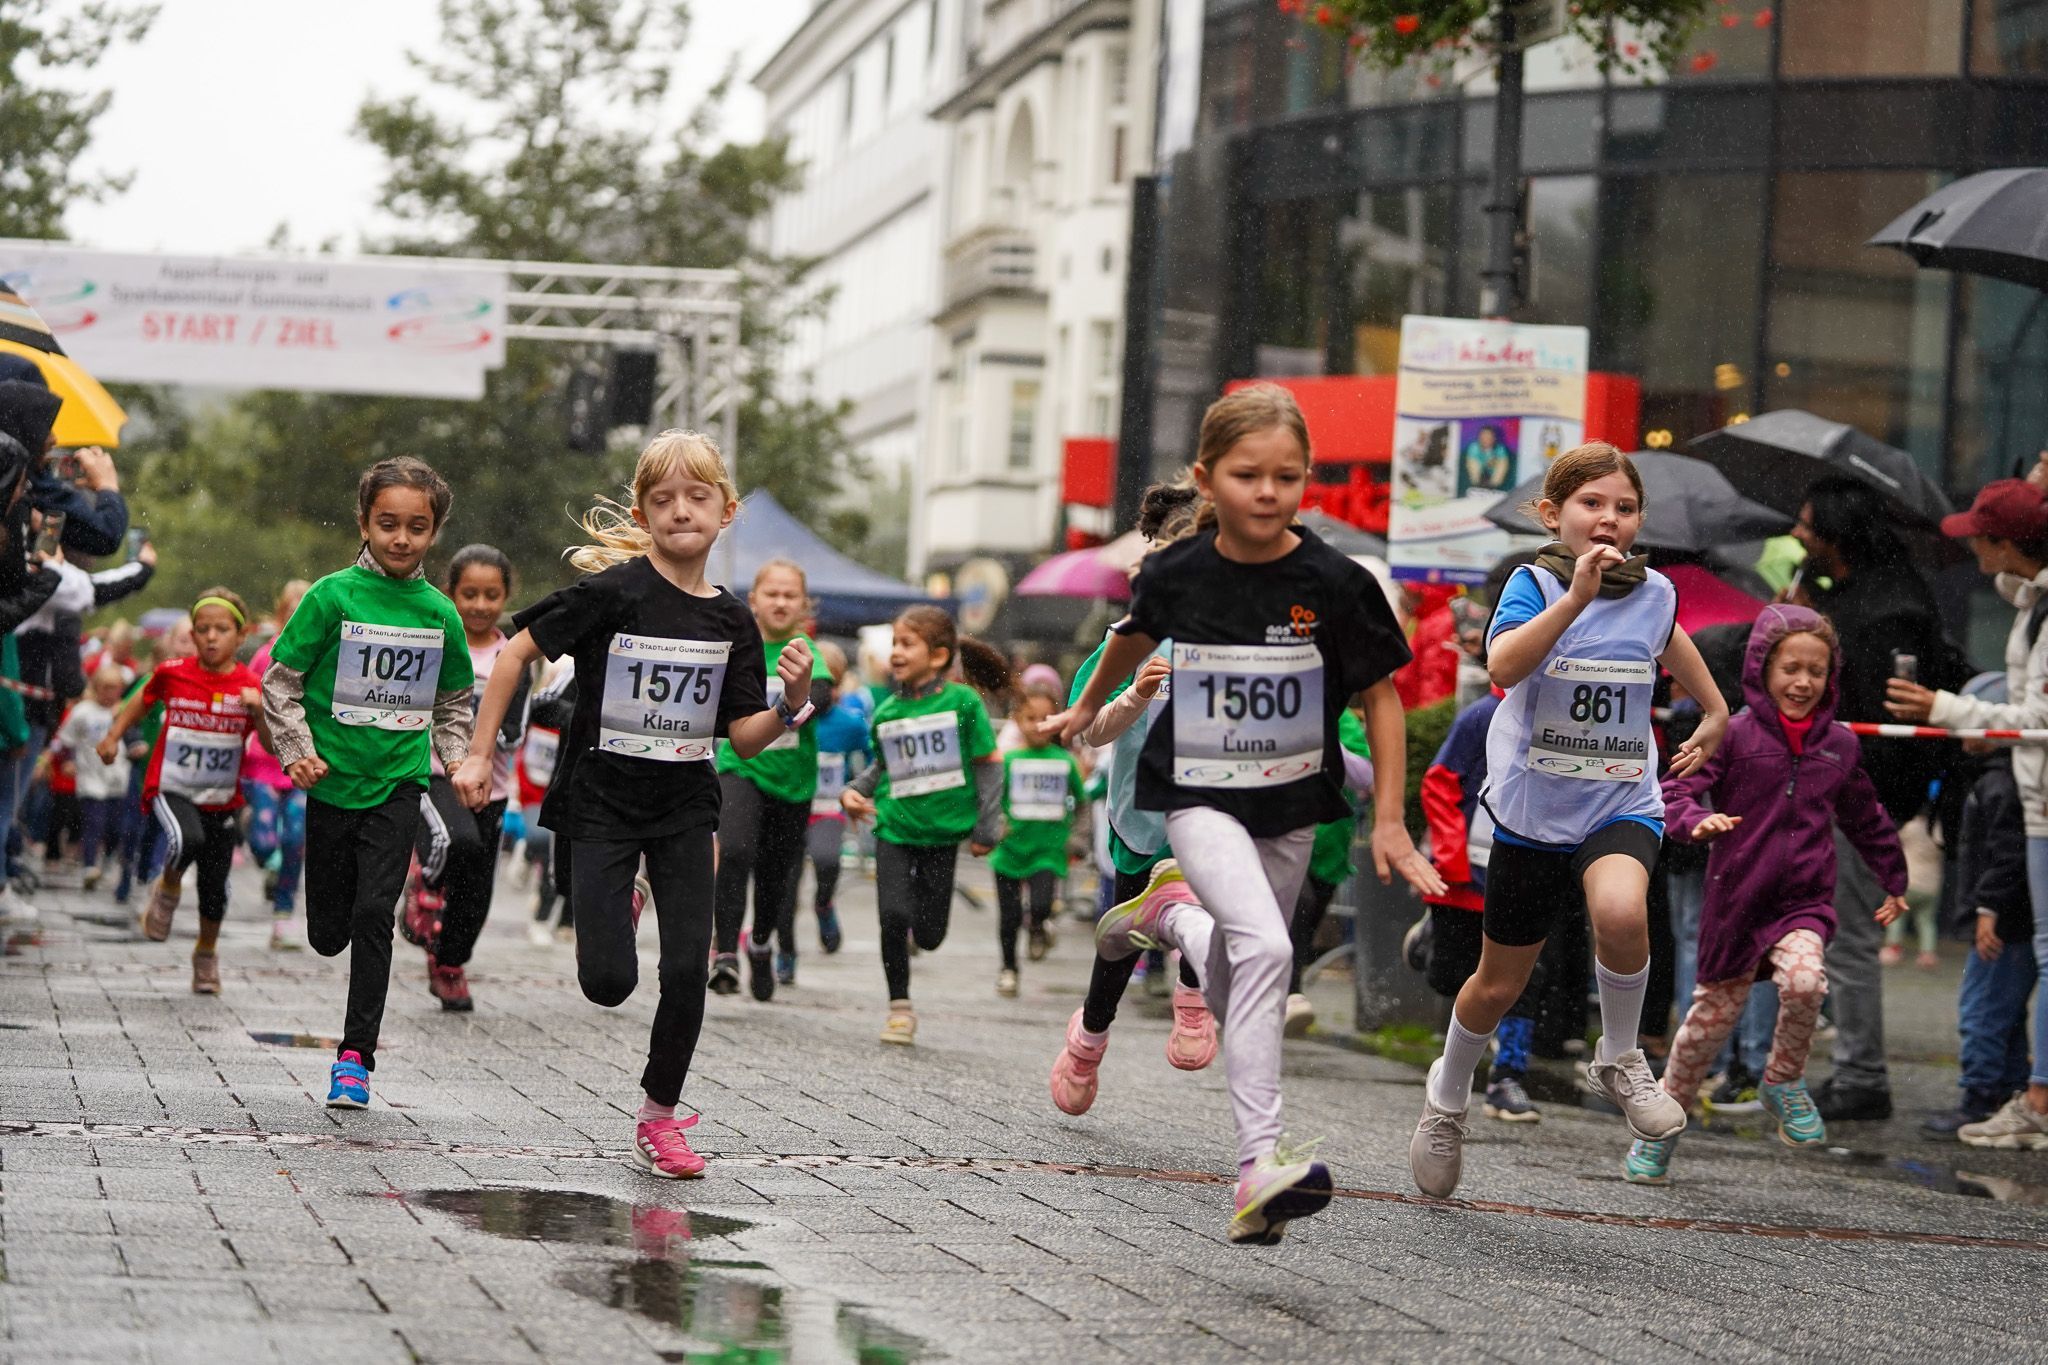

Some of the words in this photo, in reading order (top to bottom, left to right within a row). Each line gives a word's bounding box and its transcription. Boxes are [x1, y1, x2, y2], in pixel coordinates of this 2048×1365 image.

[141, 311, 241, 342] START
[249, 314, 270, 346] /
[276, 315, 339, 349] ZIEL
[351, 625, 364, 635] LG
[368, 629, 401, 638] STADTLAUF
[402, 632, 440, 640] GUMMERSBACH
[619, 637, 633, 649] LG
[639, 642, 677, 652] STADTLAUF
[679, 645, 725, 655] GUMMERSBACH
[1184, 649, 1201, 661] LG
[1207, 652, 1250, 661] STADTLAUF
[1253, 652, 1315, 662] GUMMERSBACH
[358, 645, 426, 682] 1021
[1555, 659, 1569, 671] LG
[1574, 664, 1608, 673] STADTLAUF
[1608, 666, 1647, 674] GUMMERSBACH
[627, 661, 713, 705] 1575
[364, 689, 411, 705] Ariana
[1199, 674, 1302, 721] 1560
[1569, 684, 1627, 724] 861
[643, 713, 690, 733] Klara
[894, 730, 946, 760] 1018
[1223, 734, 1277, 753] Luna
[1542, 728, 1599, 751] Emma
[1604, 736, 1644, 753] Marie
[177, 744, 233, 772] 2132
